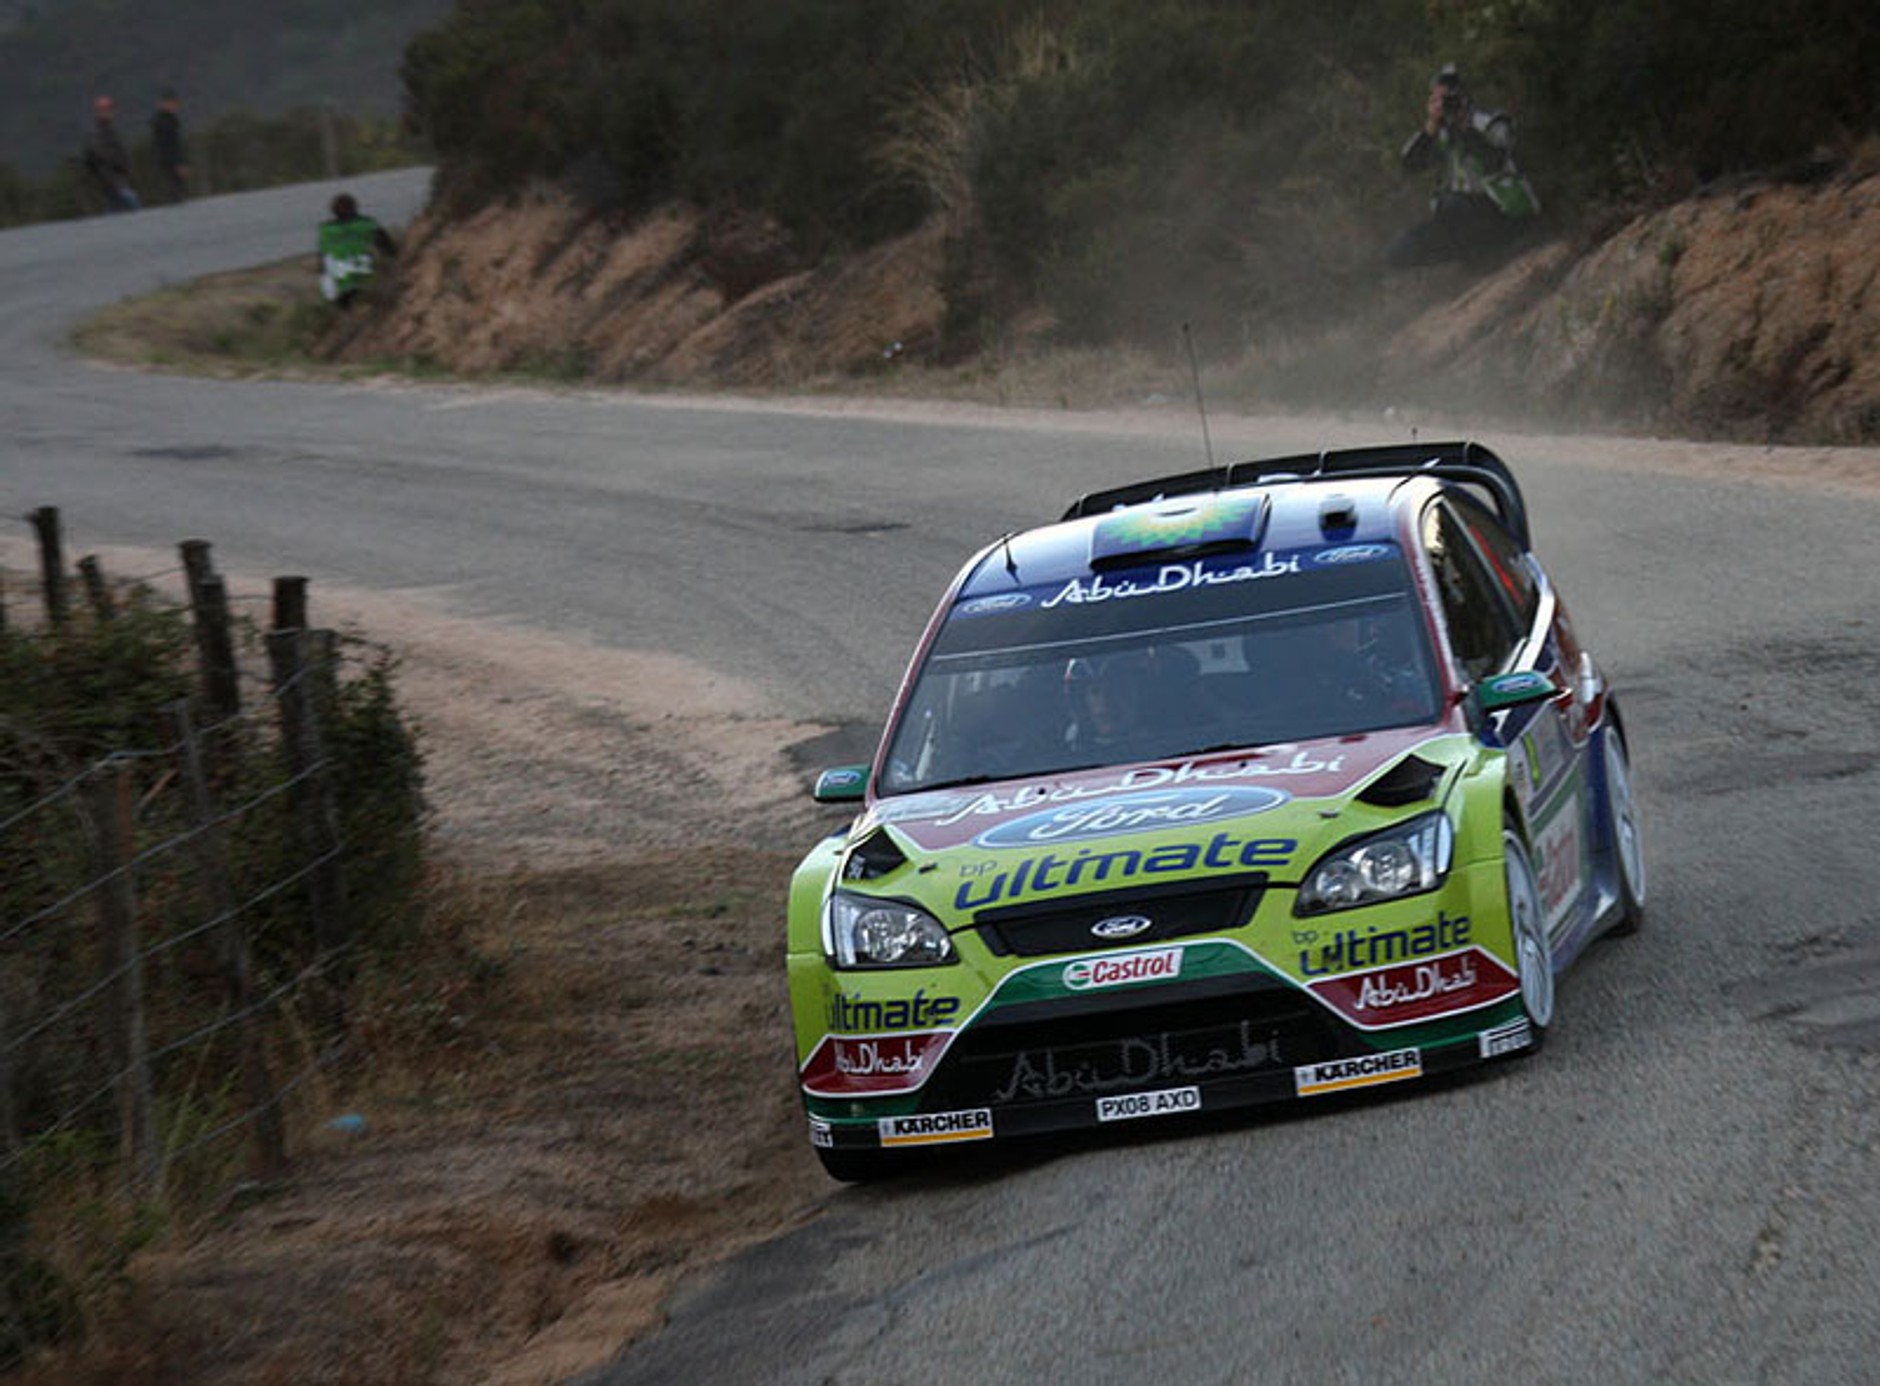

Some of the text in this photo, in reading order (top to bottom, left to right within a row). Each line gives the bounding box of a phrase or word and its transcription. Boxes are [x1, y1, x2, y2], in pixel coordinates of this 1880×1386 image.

[1028, 794, 1232, 839] Ford
[954, 832, 1298, 910] ultimate
[1300, 911, 1471, 976] ultimate
[1093, 952, 1174, 984] Castrol
[1101, 1089, 1196, 1117] PX08 AXD
